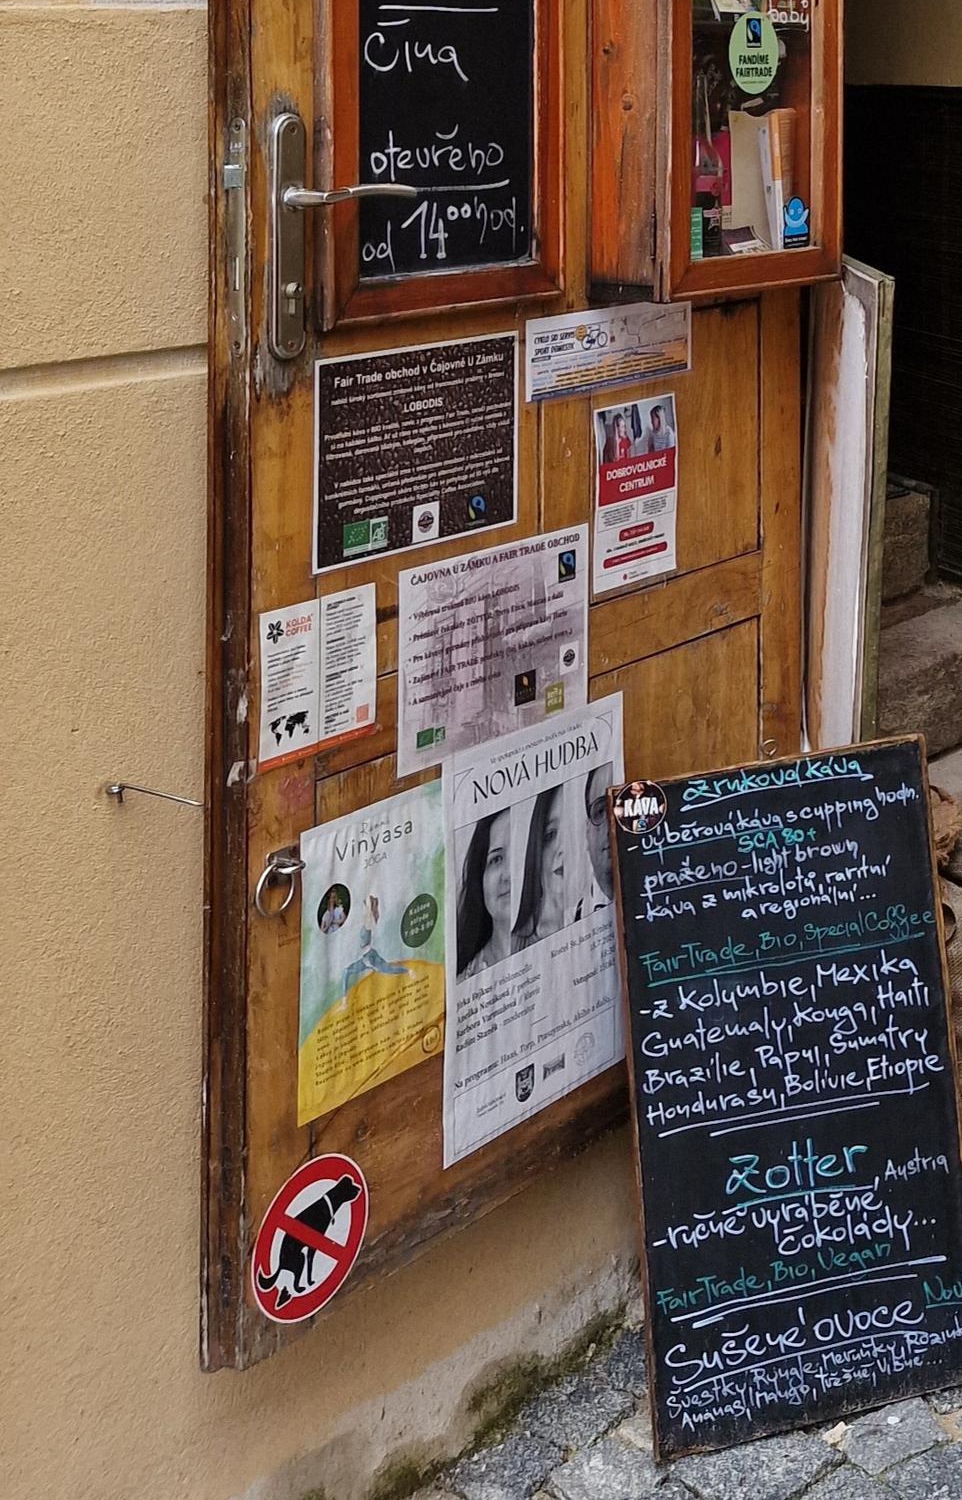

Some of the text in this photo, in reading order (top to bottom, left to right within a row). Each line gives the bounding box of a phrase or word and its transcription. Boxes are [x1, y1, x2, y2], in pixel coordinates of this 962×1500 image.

[735, 66, 773, 79] FAIRTRADE
[738, 52, 769, 66] FANDÍME
[370, 124, 504, 182] otevřeno
[362, 220, 396, 274] od
[334, 376, 354, 389] Fair
[356, 371, 383, 385] Trade
[385, 365, 420, 381] obchod
[421, 366, 427, 374] v
[467, 356, 474, 367] U
[475, 352, 504, 365] Zámku
[403, 397, 444, 414] LOBODIS
[606, 455, 667, 481] DOBROVOLNICKÉ
[619, 475, 655, 493] CENTRUM
[410, 568, 452, 586] ČAJOVNA
[453, 565, 460, 575] U
[461, 557, 491, 573] ZÁMKU
[499, 550, 518, 563] FAIR
[519, 544, 546, 557] TRADE
[547, 533, 580, 547] OBCHOD
[285, 614, 312, 631] KOLDA
[285, 622, 312, 638] COFFEE
[472, 754, 530, 804] NOVÁ
[535, 732, 599, 777] HUDBA
[624, 793, 659, 817] KÁVA
[737, 808, 784, 831] káva
[336, 820, 413, 862] Vinyasa
[738, 828, 817, 854] SCA 80+
[794, 839, 860, 865] brown
[817, 948, 919, 988] Mexika
[876, 976, 931, 1010] Haiti
[830, 1014, 929, 1056] Sumatry
[867, 1053, 945, 1095] Etiopie
[884, 1147, 950, 1182] Austria
[817, 1243, 892, 1276] Vegan
[664, 1301, 926, 1385] Sušené ovoce
